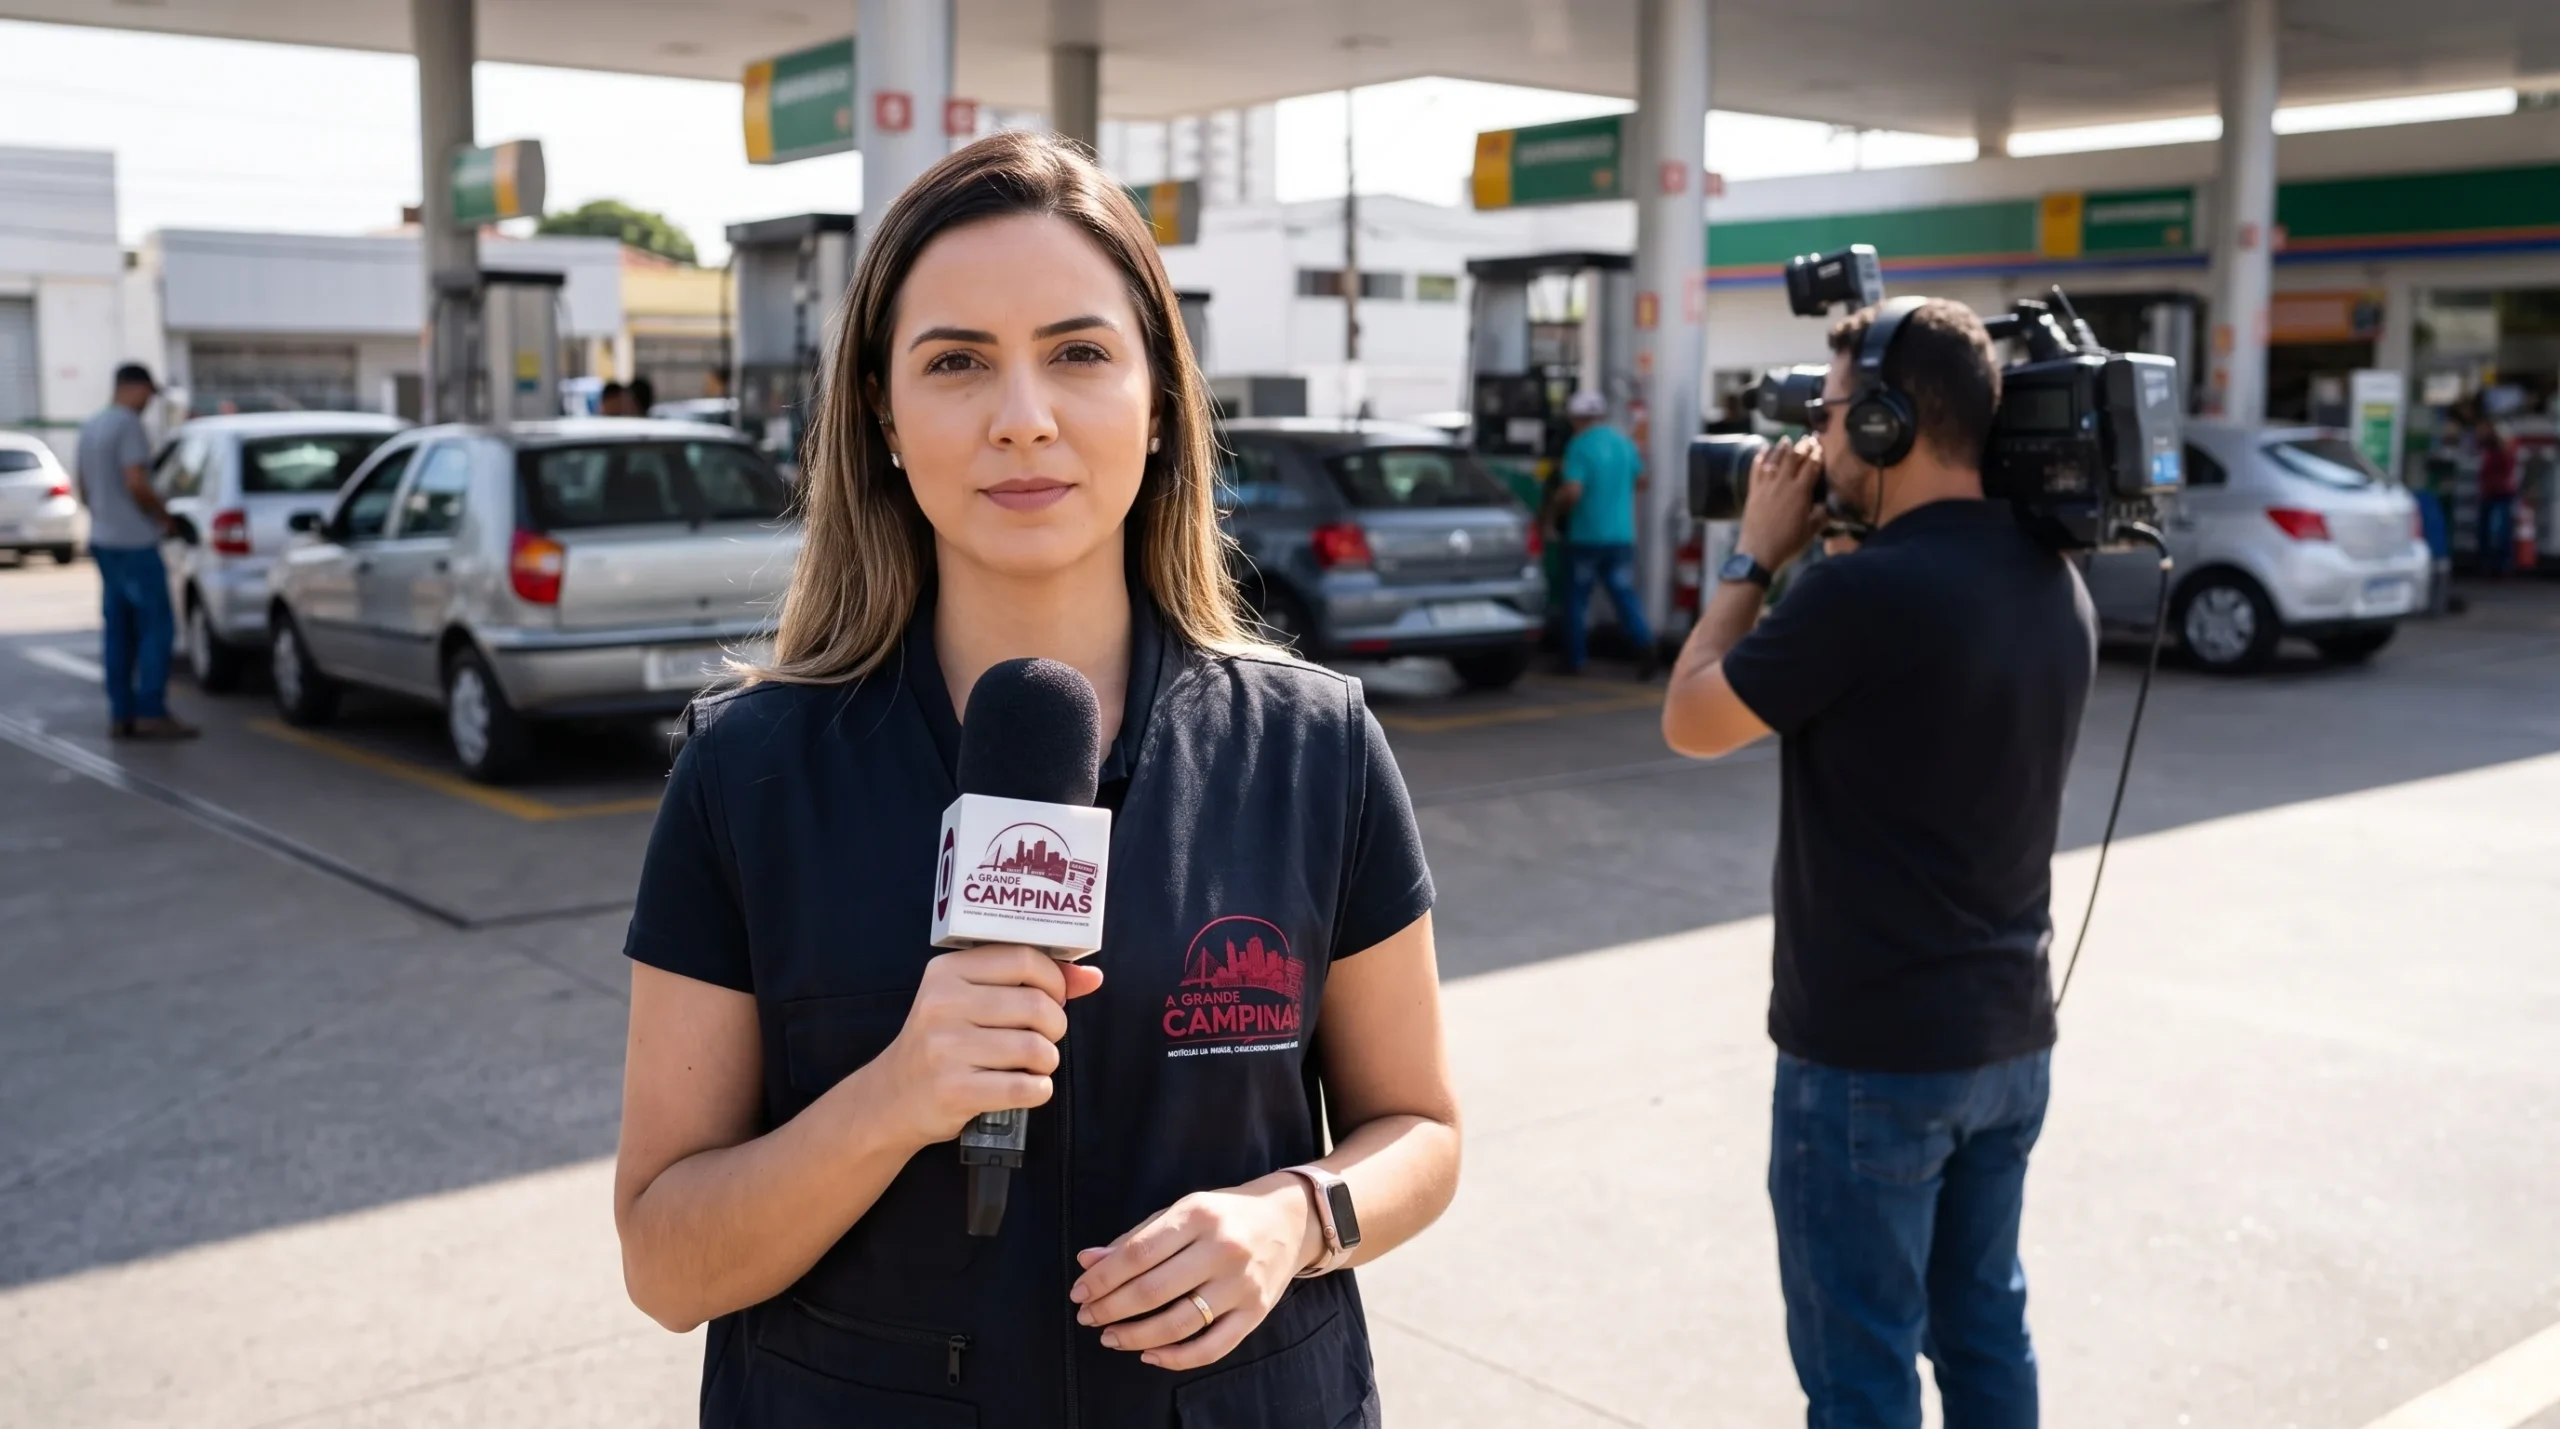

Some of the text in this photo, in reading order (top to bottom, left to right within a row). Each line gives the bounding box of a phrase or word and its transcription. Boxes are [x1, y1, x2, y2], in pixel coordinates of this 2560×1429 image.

[979, 874, 1021, 885] GRANDE
[964, 884, 1092, 913] CAMPINAS
[1165, 991, 1240, 1007] A GRANDE
